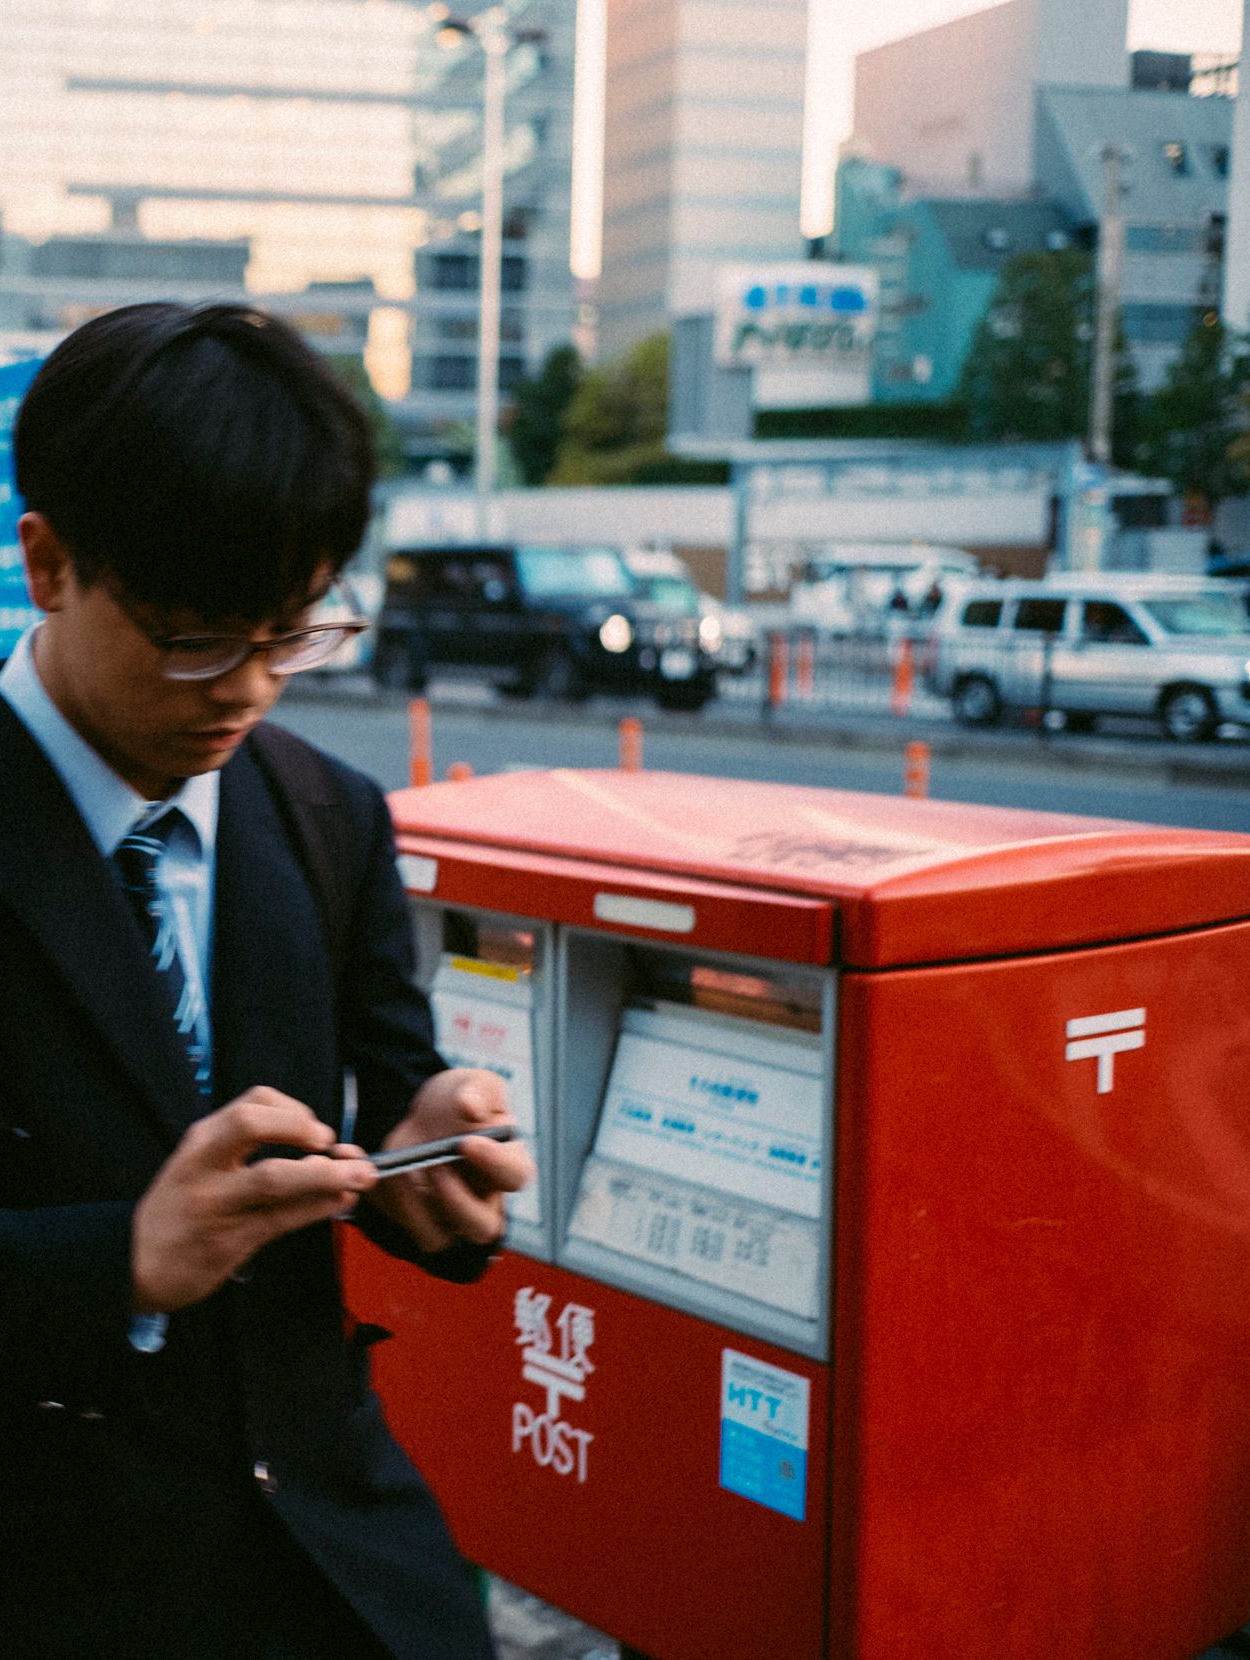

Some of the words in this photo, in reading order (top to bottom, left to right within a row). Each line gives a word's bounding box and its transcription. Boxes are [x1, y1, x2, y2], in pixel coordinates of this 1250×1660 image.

[514, 1287, 596, 1374] 郵便
[728, 1381, 782, 1419] HTT
[512, 1402, 595, 1483] POST
